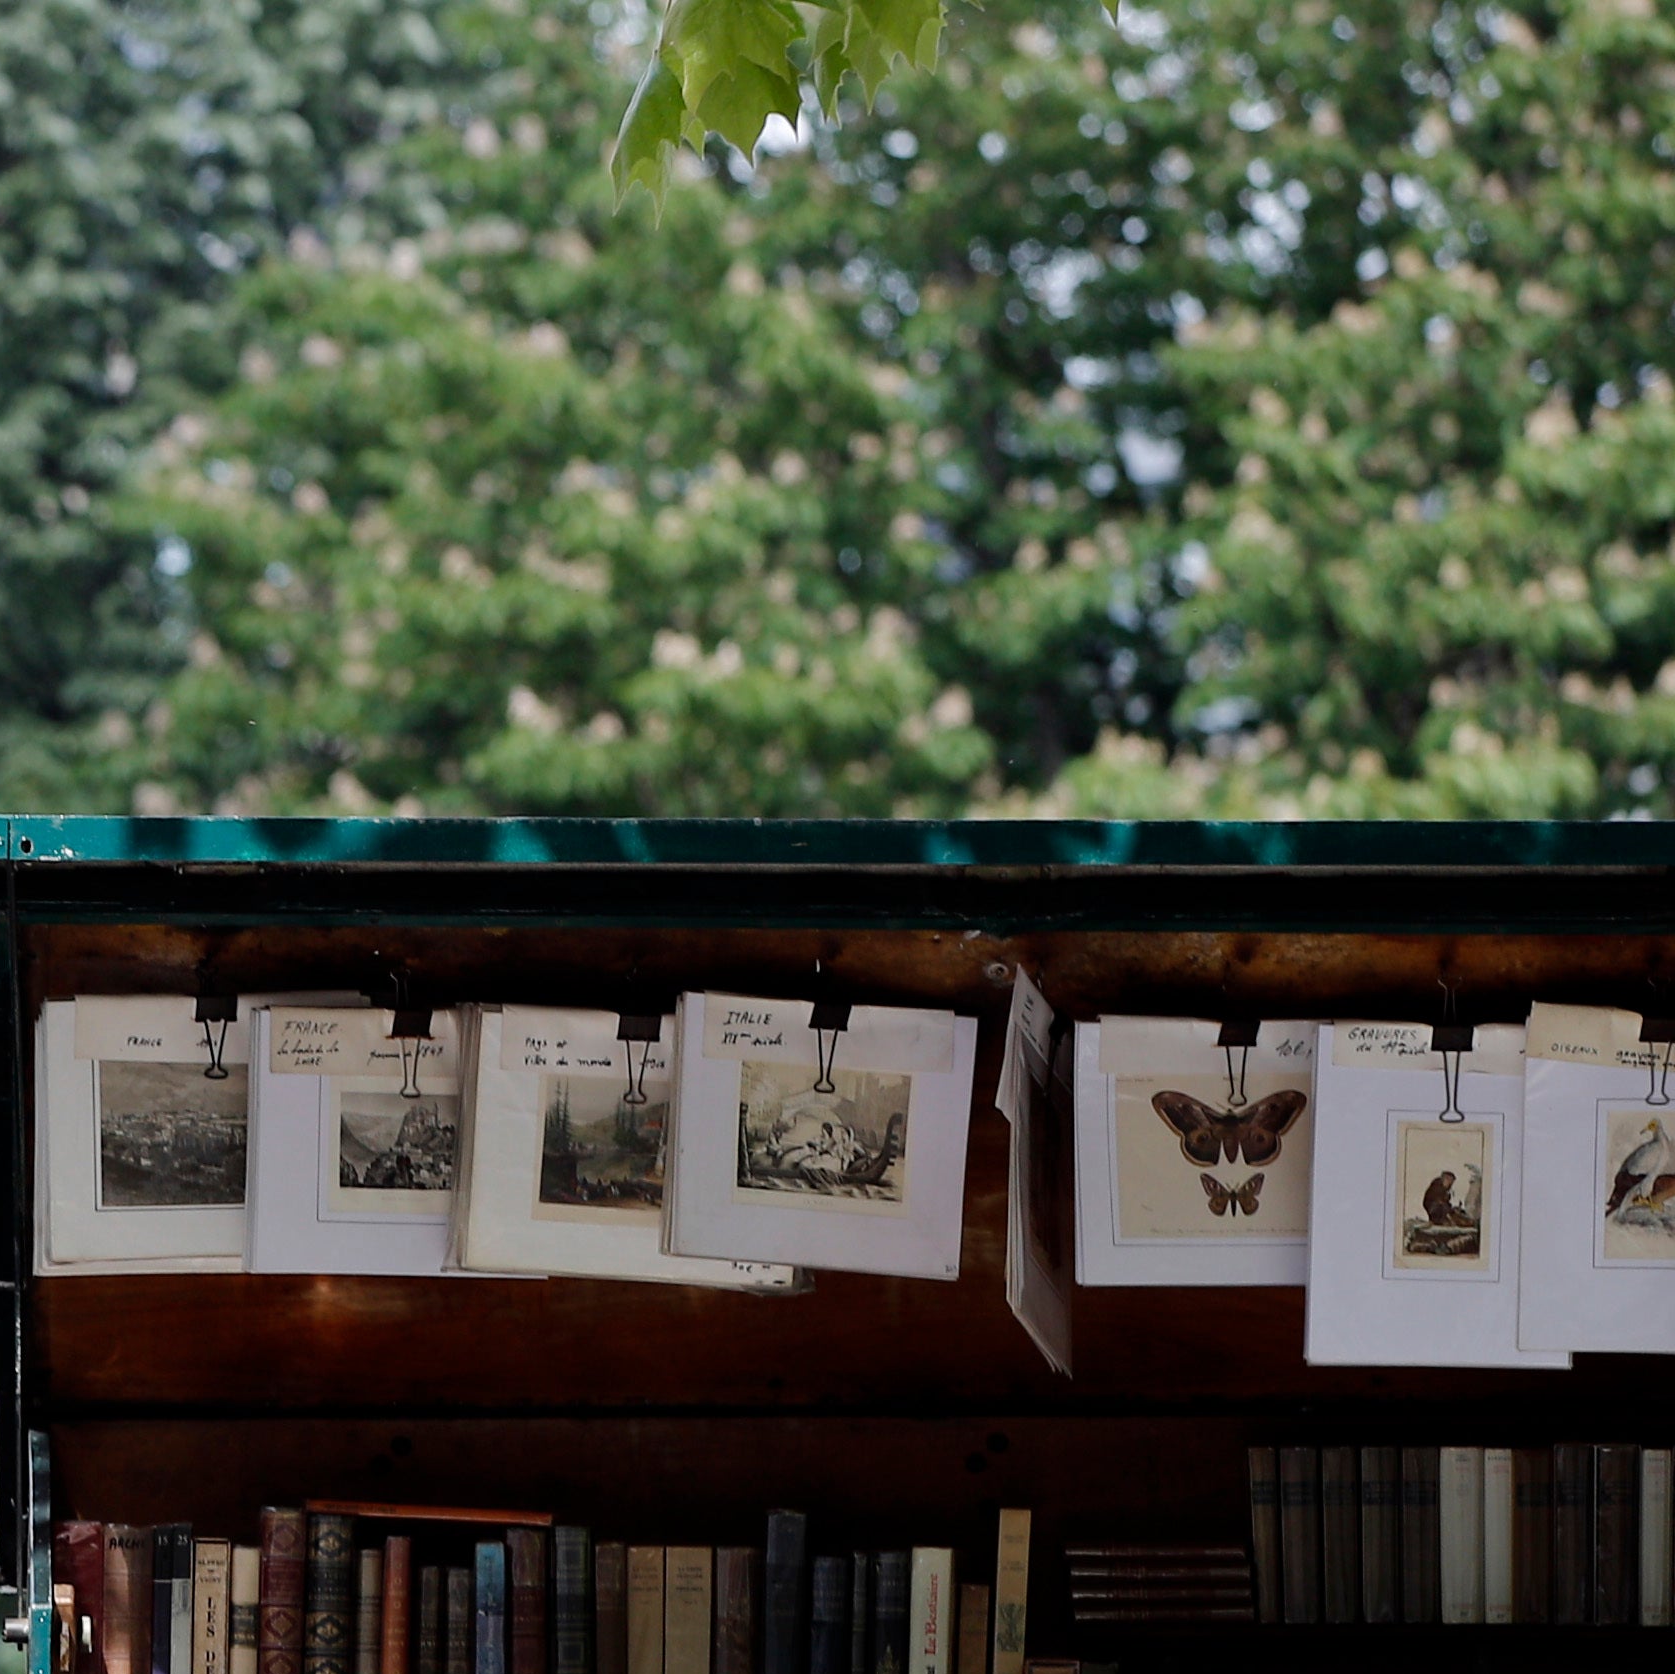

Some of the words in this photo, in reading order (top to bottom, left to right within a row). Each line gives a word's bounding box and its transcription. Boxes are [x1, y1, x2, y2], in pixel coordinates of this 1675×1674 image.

[723, 1011, 772, 1026] ITALIE
[282, 1020, 339, 1036] FRANCE
[1550, 1042, 1599, 1056] OISEAUX
